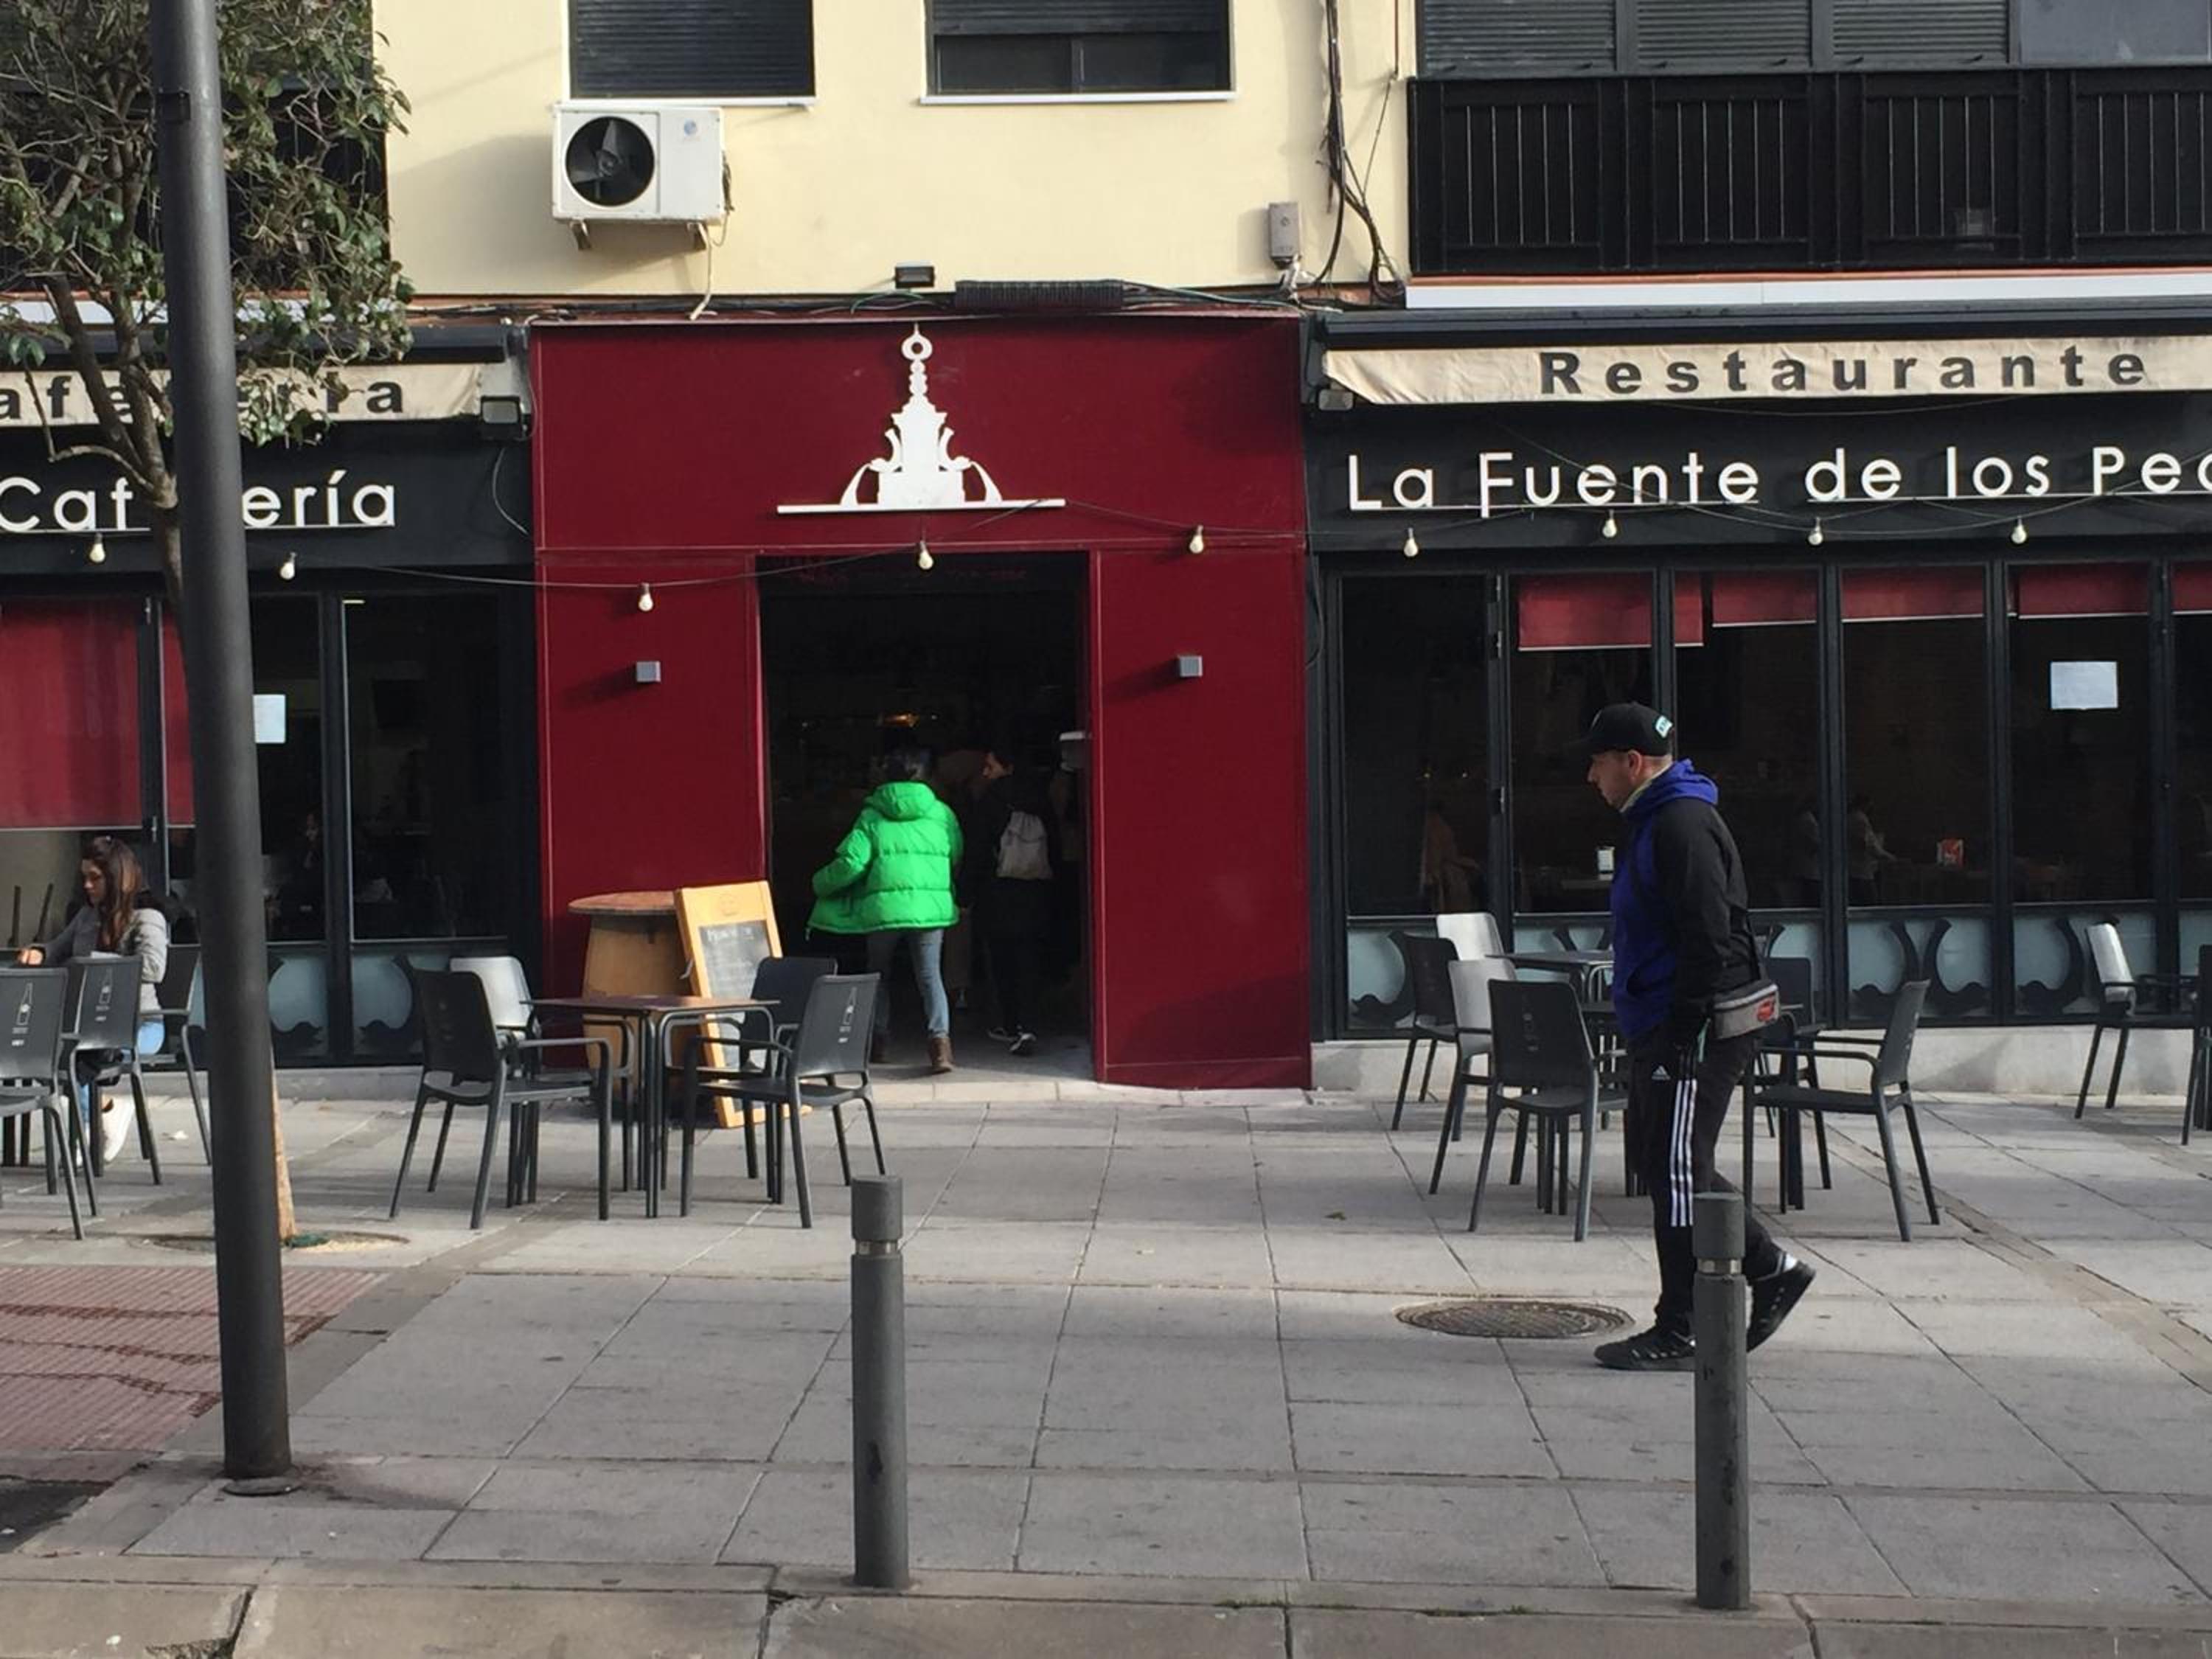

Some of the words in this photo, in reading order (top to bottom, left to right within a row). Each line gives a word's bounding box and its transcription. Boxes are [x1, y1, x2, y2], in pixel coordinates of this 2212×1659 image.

[1540, 346, 2145, 394] Restaurante
[0, 470, 394, 531] Cafería
[1349, 455, 1433, 510] La
[1480, 452, 1759, 518] Fuente
[1805, 448, 1902, 500] de
[1947, 446, 2050, 498] los
